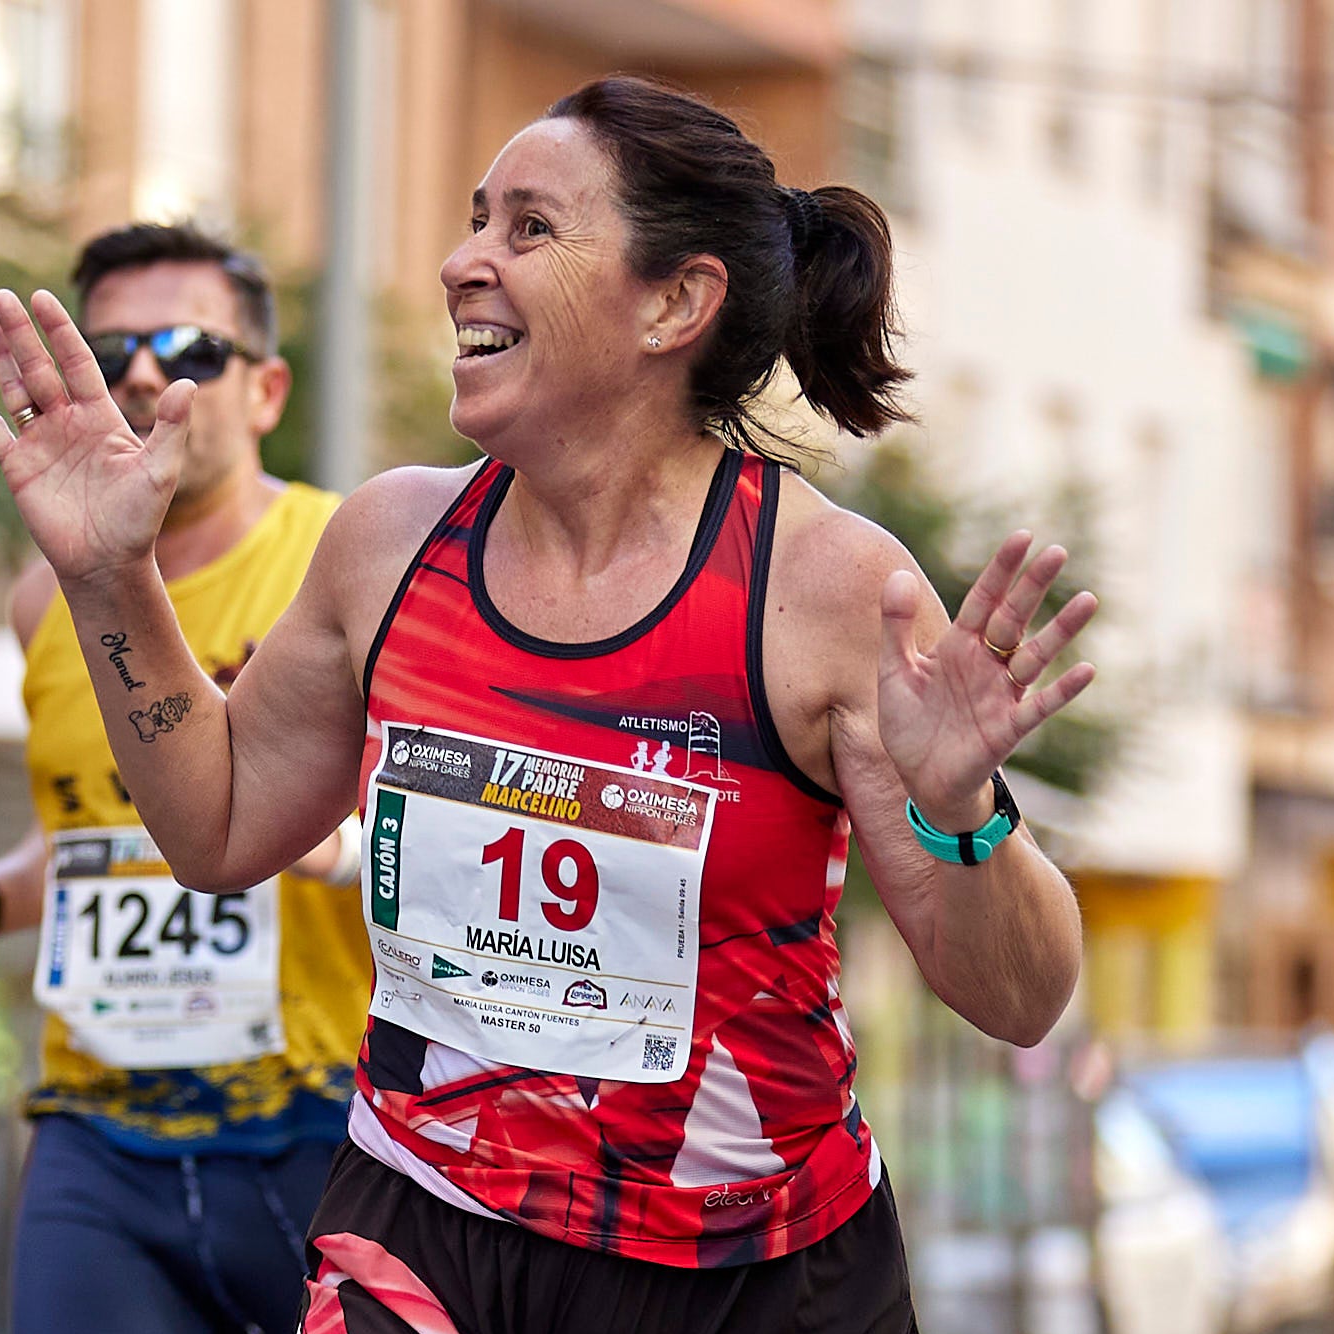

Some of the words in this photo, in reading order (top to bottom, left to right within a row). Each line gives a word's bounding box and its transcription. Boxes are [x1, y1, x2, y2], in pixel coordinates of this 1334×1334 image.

[101, 632, 146, 692] Manuel
[618, 715, 688, 733] ATLETISMO
[408, 758, 439, 772] NIPPON
[441, 764, 470, 779] GASES
[411, 744, 472, 767] OXIMESA
[489, 749, 526, 786] 17
[523, 754, 585, 782] MEMORIAL
[521, 772, 579, 800] PADRE
[480, 783, 582, 821] MARCELINO
[624, 803, 661, 819] NIPPON
[663, 811, 697, 827] GASES
[627, 788, 698, 816] OXIMESA
[382, 817, 399, 832] 3
[375, 837, 396, 900] CAJÓN
[481, 826, 600, 933] 19
[78, 890, 250, 959] 1245
[380, 942, 421, 966] CALERO
[466, 925, 534, 960] MARÍA
[538, 938, 601, 971] LUISA
[677, 930, 685, 959] PRUEBA
[500, 973, 551, 989] OXIMESA
[479, 1002, 503, 1014] LUISA
[505, 1007, 540, 1020] CANTÓN
[541, 1013, 580, 1026] FUENTES
[619, 992, 677, 1014] ANAYA
[480, 1014, 526, 1031] MASTER
[528, 1023, 541, 1034] 50
